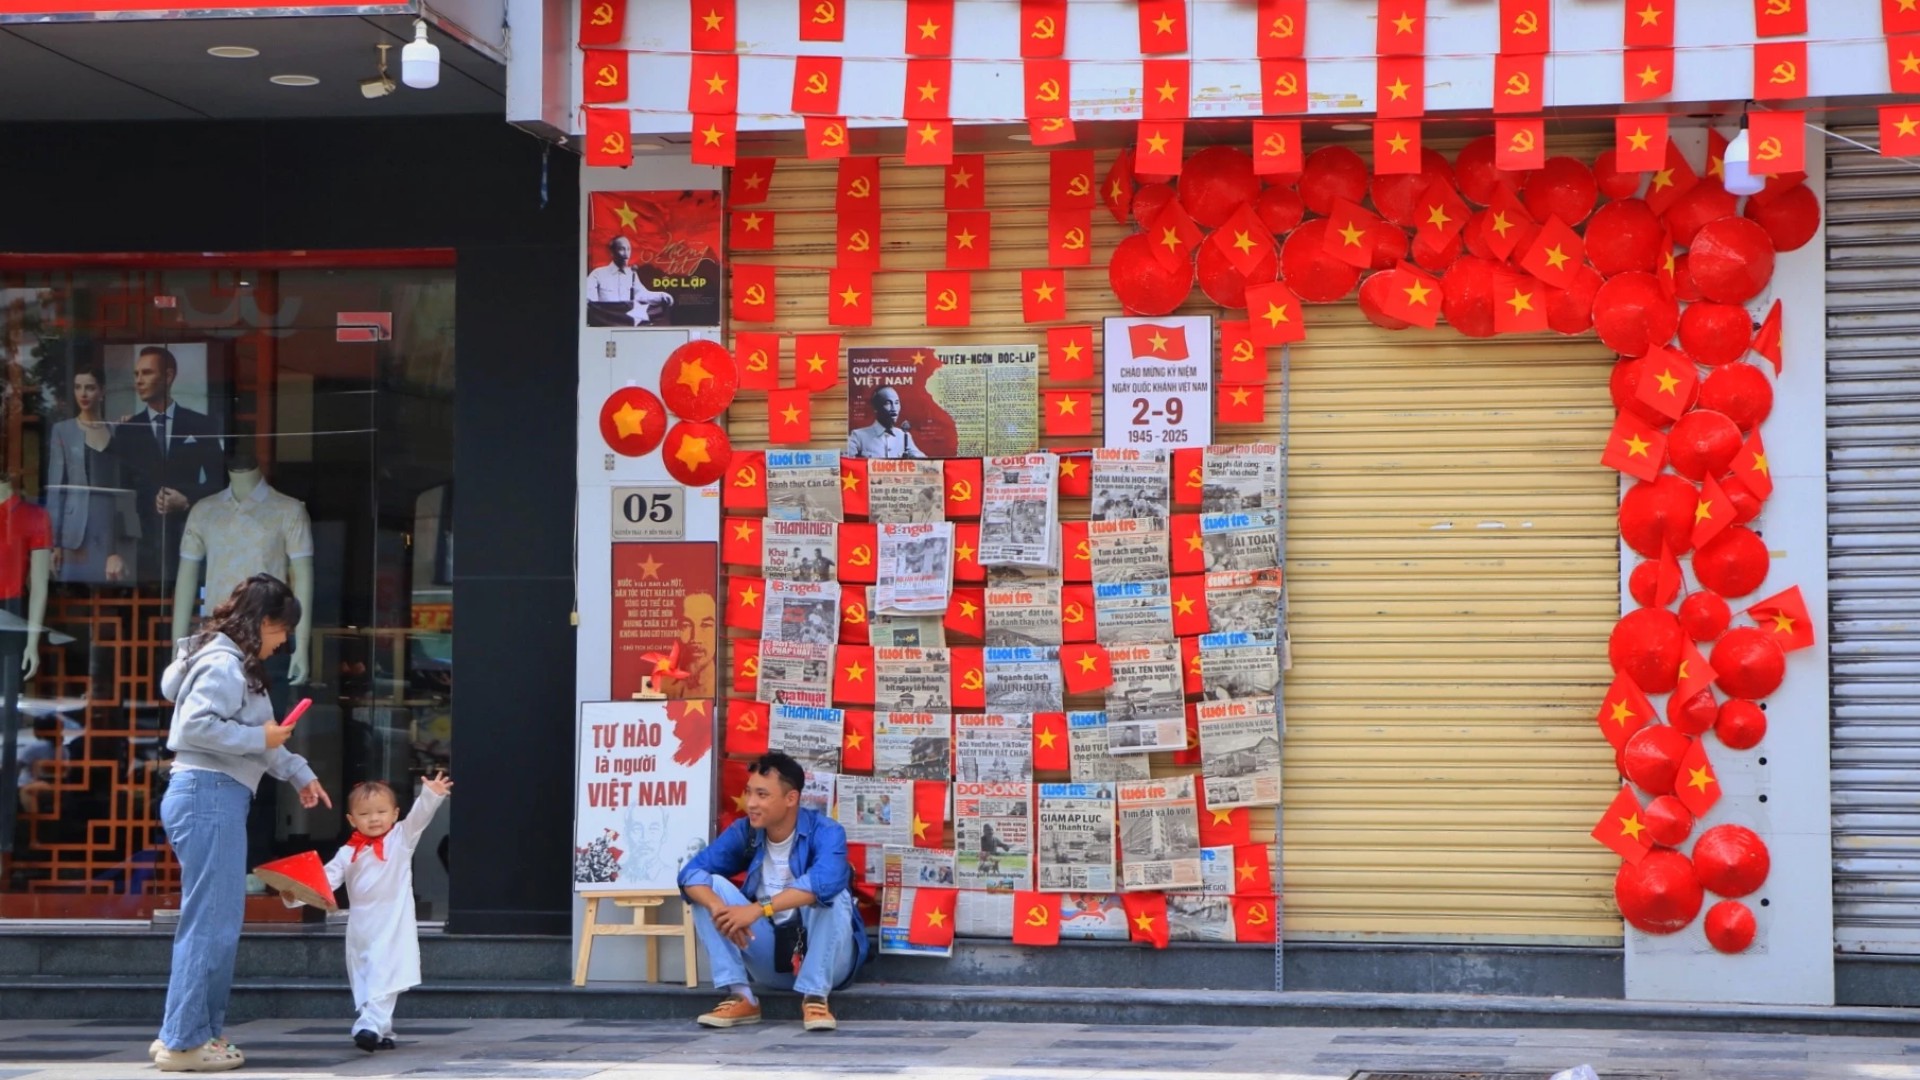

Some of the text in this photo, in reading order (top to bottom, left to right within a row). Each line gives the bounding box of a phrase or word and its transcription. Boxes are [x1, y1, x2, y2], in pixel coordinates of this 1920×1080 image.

[653, 276, 678, 289] ĐỘC
[853, 364, 917, 374] QUỐC KHÁNH
[1120, 366, 1141, 378] CHÀO
[1142, 365, 1165, 378] MỪNG
[1178, 366, 1197, 378] NIỆM
[854, 375, 913, 388] VIỆT NAM
[1112, 382, 1208, 393] NGÀY QUỐC KHÁNH VIỆT NAM
[1132, 398, 1183, 425] 2-9
[1128, 430, 1152, 443] 1945
[1162, 430, 1188, 442] 2025
[624, 494, 673, 523] 05
[768, 548, 788, 557] Khai
[641, 588, 653, 598] VIỆT
[654, 589, 666, 597] NAM
[592, 719, 662, 753] TỰ HÀO
[596, 755, 656, 776] là người
[588, 778, 687, 811] VIỆT NAM
[1059, 823, 1082, 831] thanh
